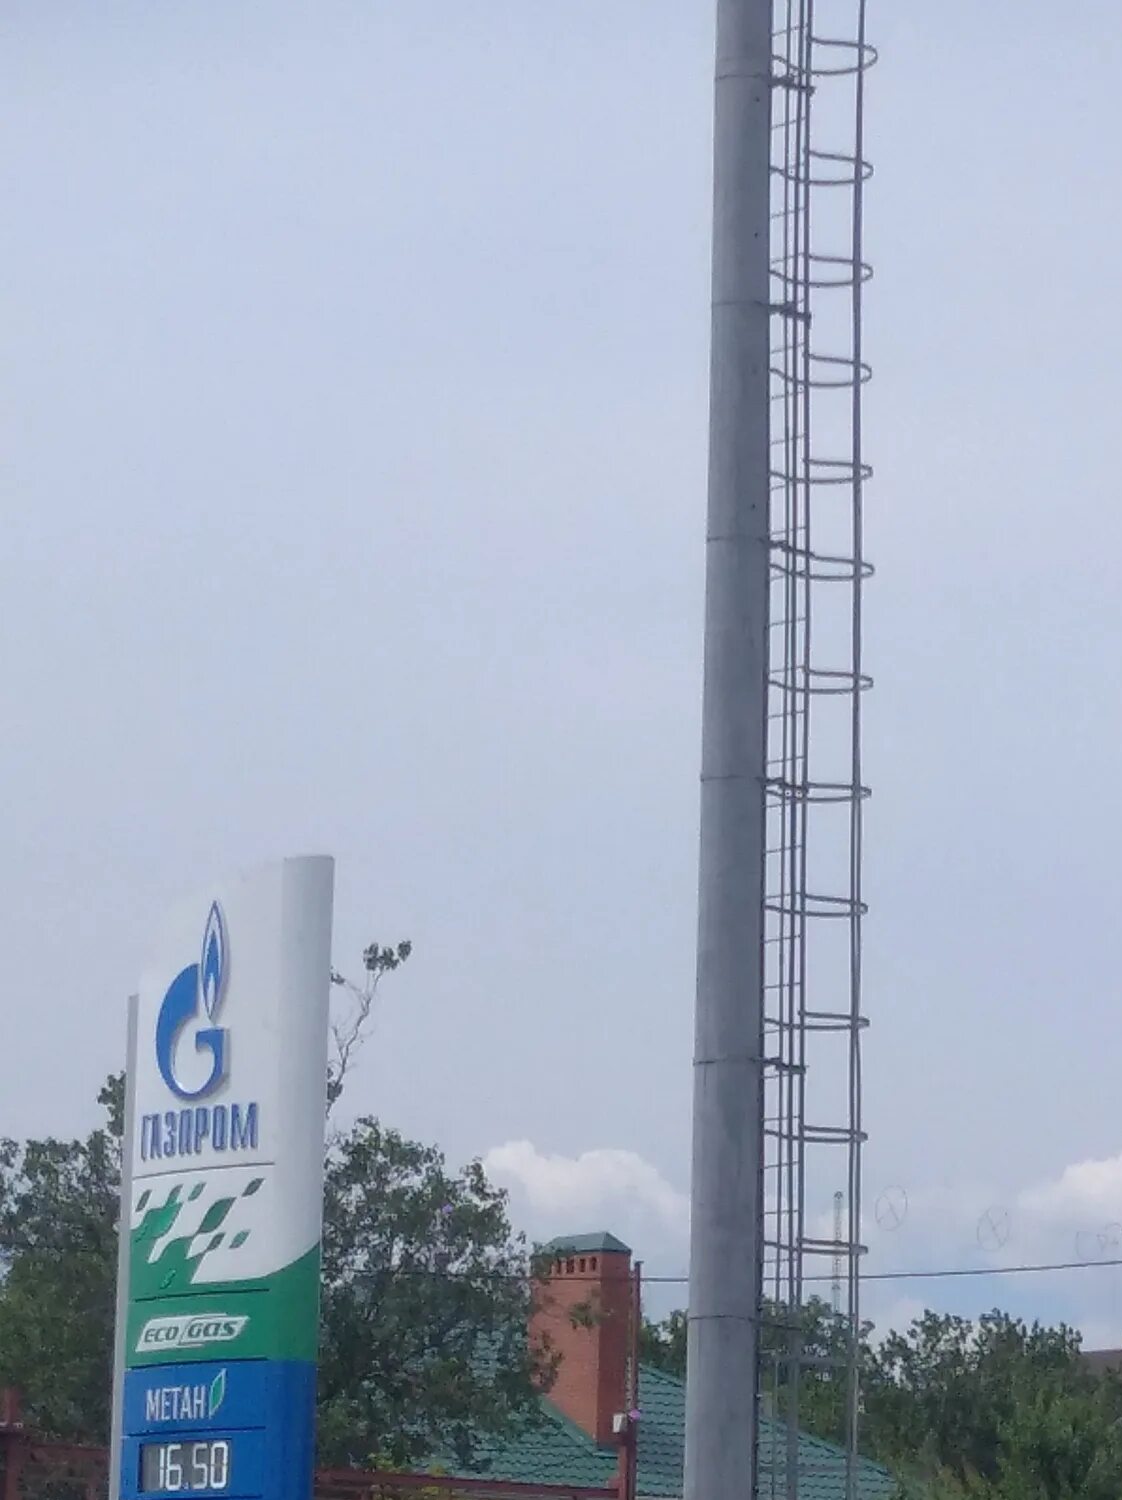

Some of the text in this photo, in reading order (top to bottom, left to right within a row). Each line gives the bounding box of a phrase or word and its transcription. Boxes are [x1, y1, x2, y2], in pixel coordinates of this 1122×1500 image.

[141, 1103, 259, 1161] ГАЗПРОМ
[145, 1326, 179, 1342] ECO
[147, 1386, 206, 1421] МЕТАН
